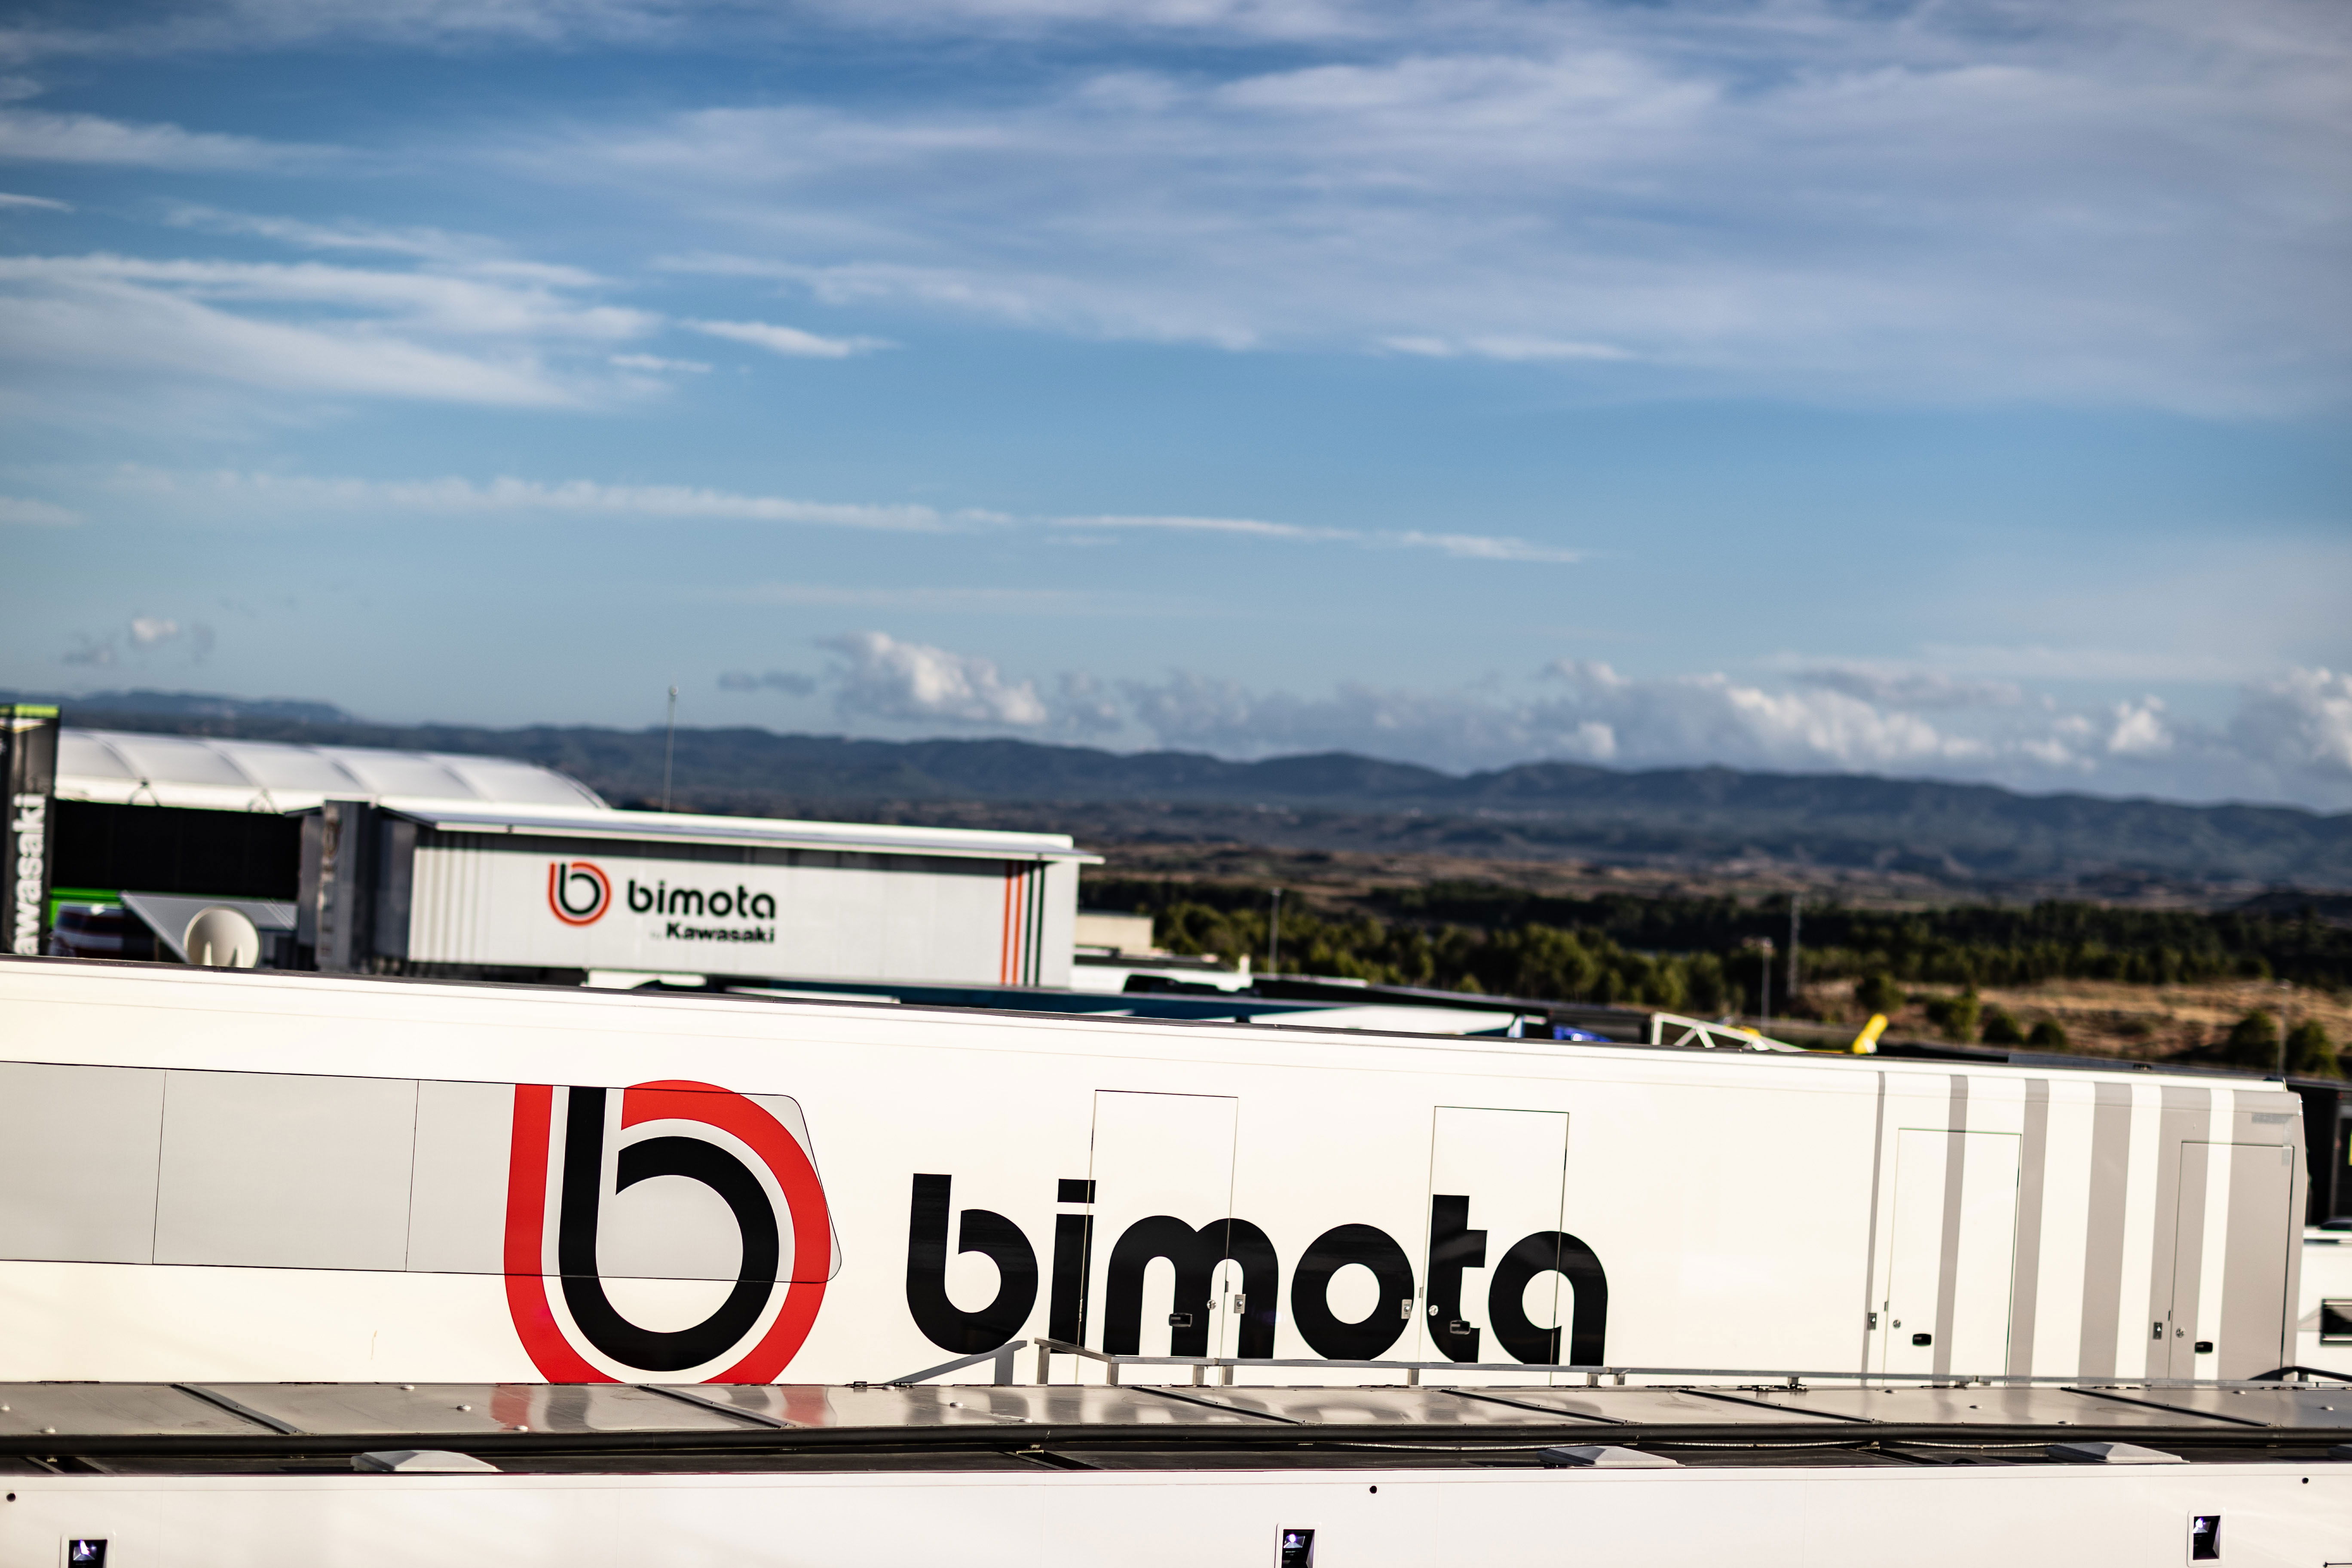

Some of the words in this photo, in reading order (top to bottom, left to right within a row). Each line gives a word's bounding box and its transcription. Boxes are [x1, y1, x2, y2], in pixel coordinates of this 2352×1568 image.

[12, 793, 46, 955] awasaki
[627, 879, 776, 919] bimota
[665, 922, 775, 943] Kawasaki
[906, 1173, 1608, 1367] bimota
